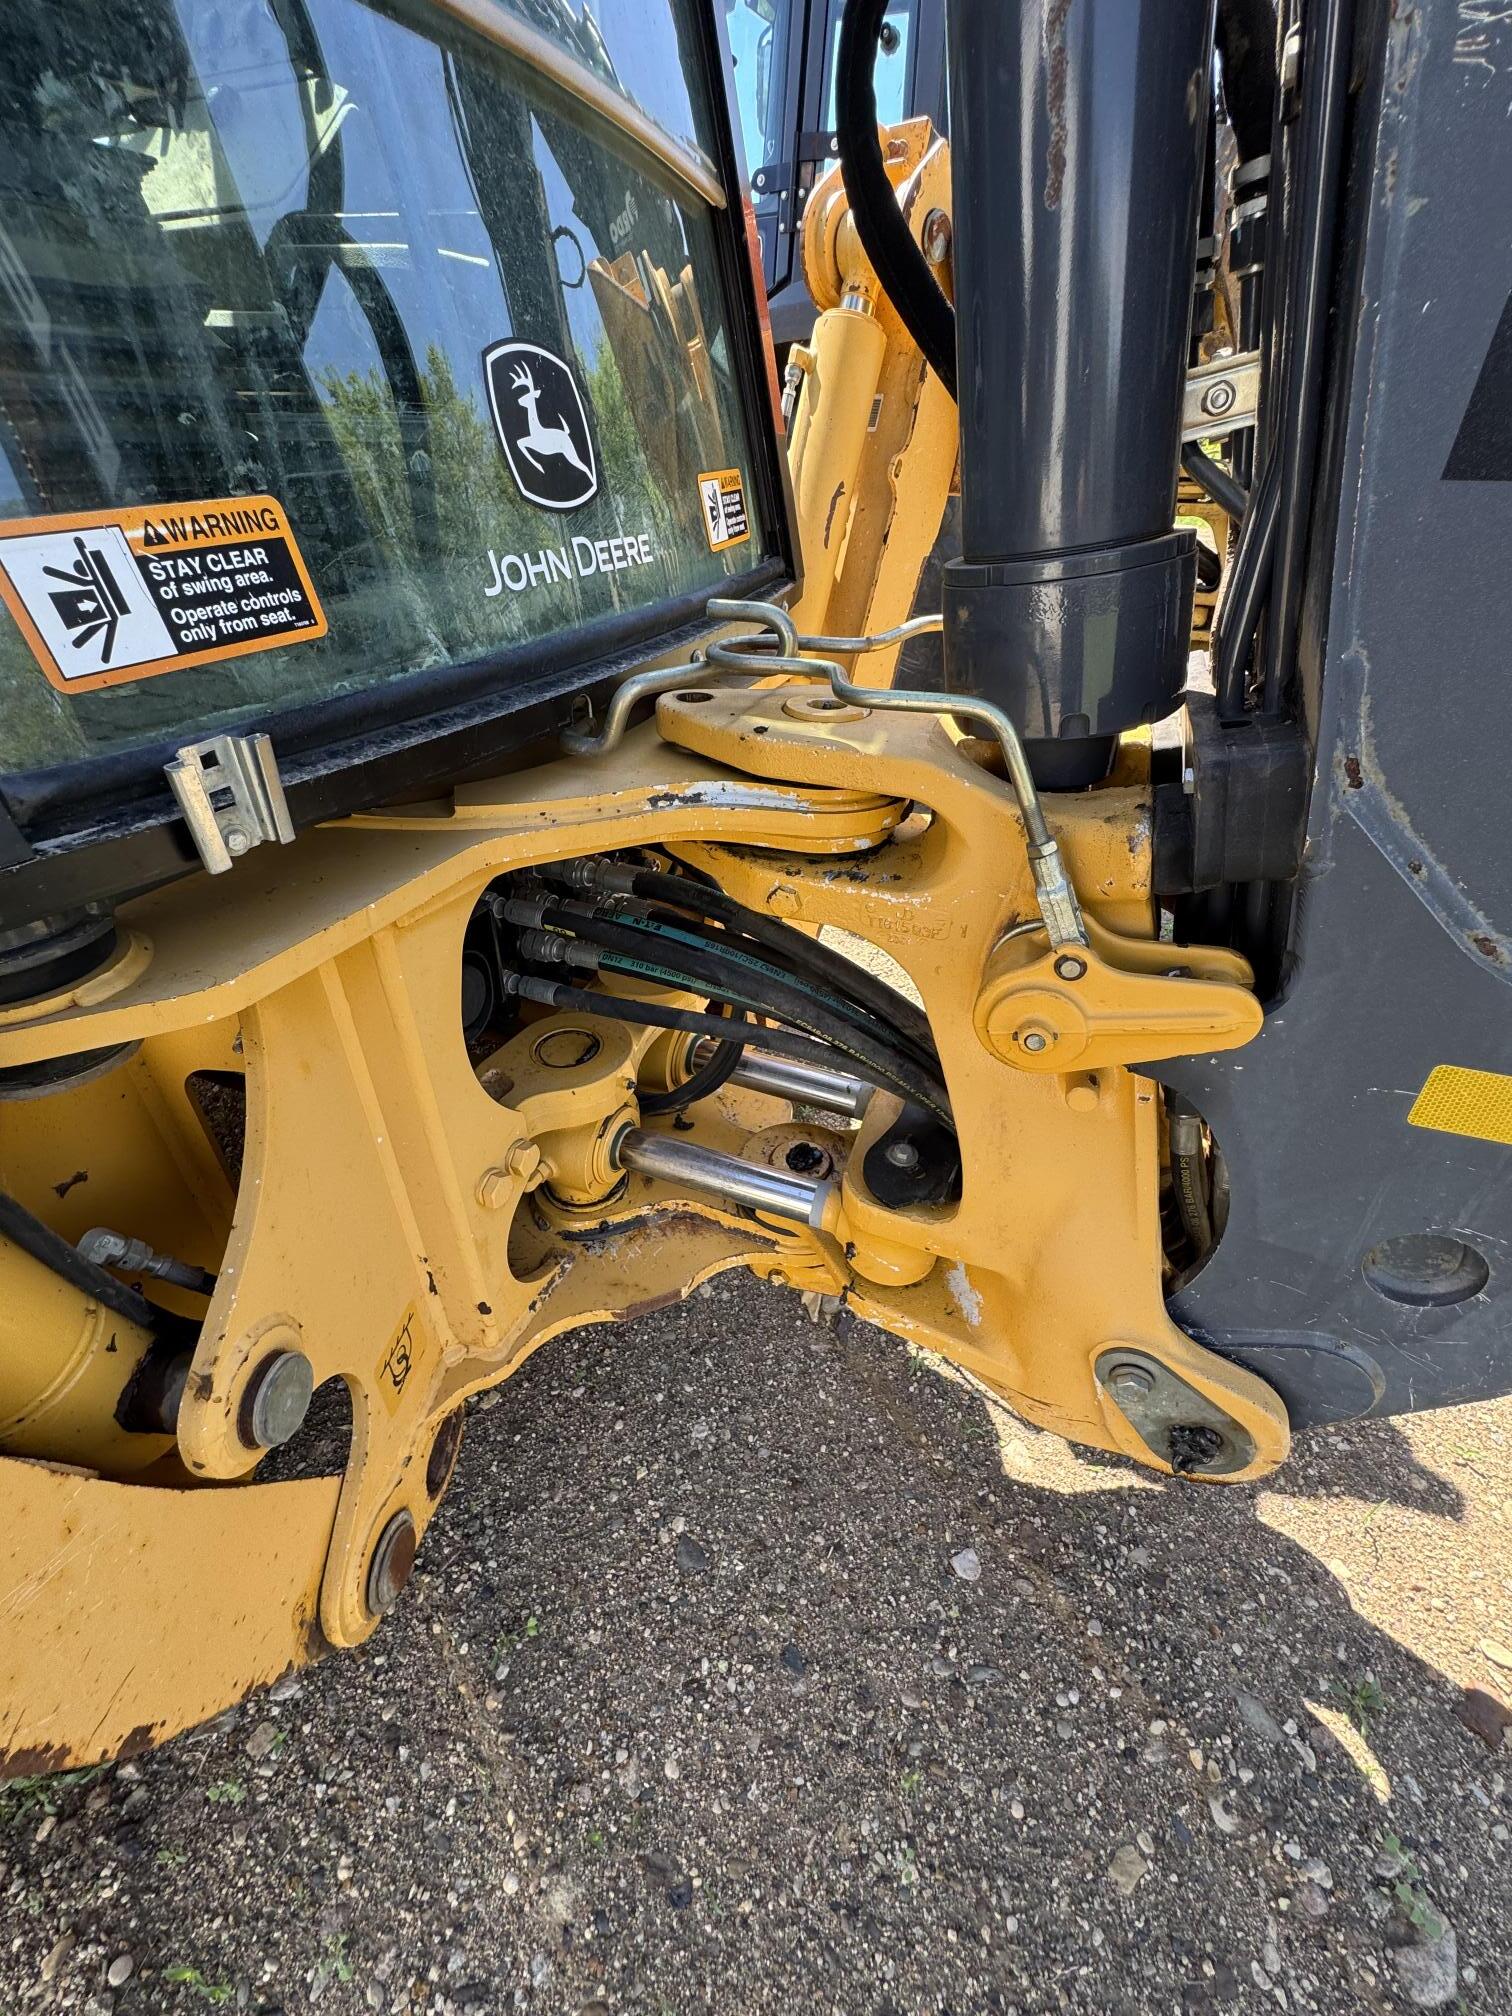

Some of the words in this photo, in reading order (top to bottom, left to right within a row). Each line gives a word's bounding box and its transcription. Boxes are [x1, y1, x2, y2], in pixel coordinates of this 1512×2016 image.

[160, 507, 280, 542] WARNING
[149, 556, 202, 581] STAY
[206, 547, 270, 572] CLEAR
[484, 547, 572, 596] JOHN
[571, 534, 653, 576] DEERE
[160, 581, 179, 600] of
[182, 573, 234, 593] swing
[235, 570, 274, 587] area.
[170, 600, 239, 626] Operate
[241, 588, 302, 611] controls
[180, 623, 217, 642] only
[219, 616, 258, 635] from
[260, 607, 296, 626] seat.
[645, 963, 659, 973] bar
